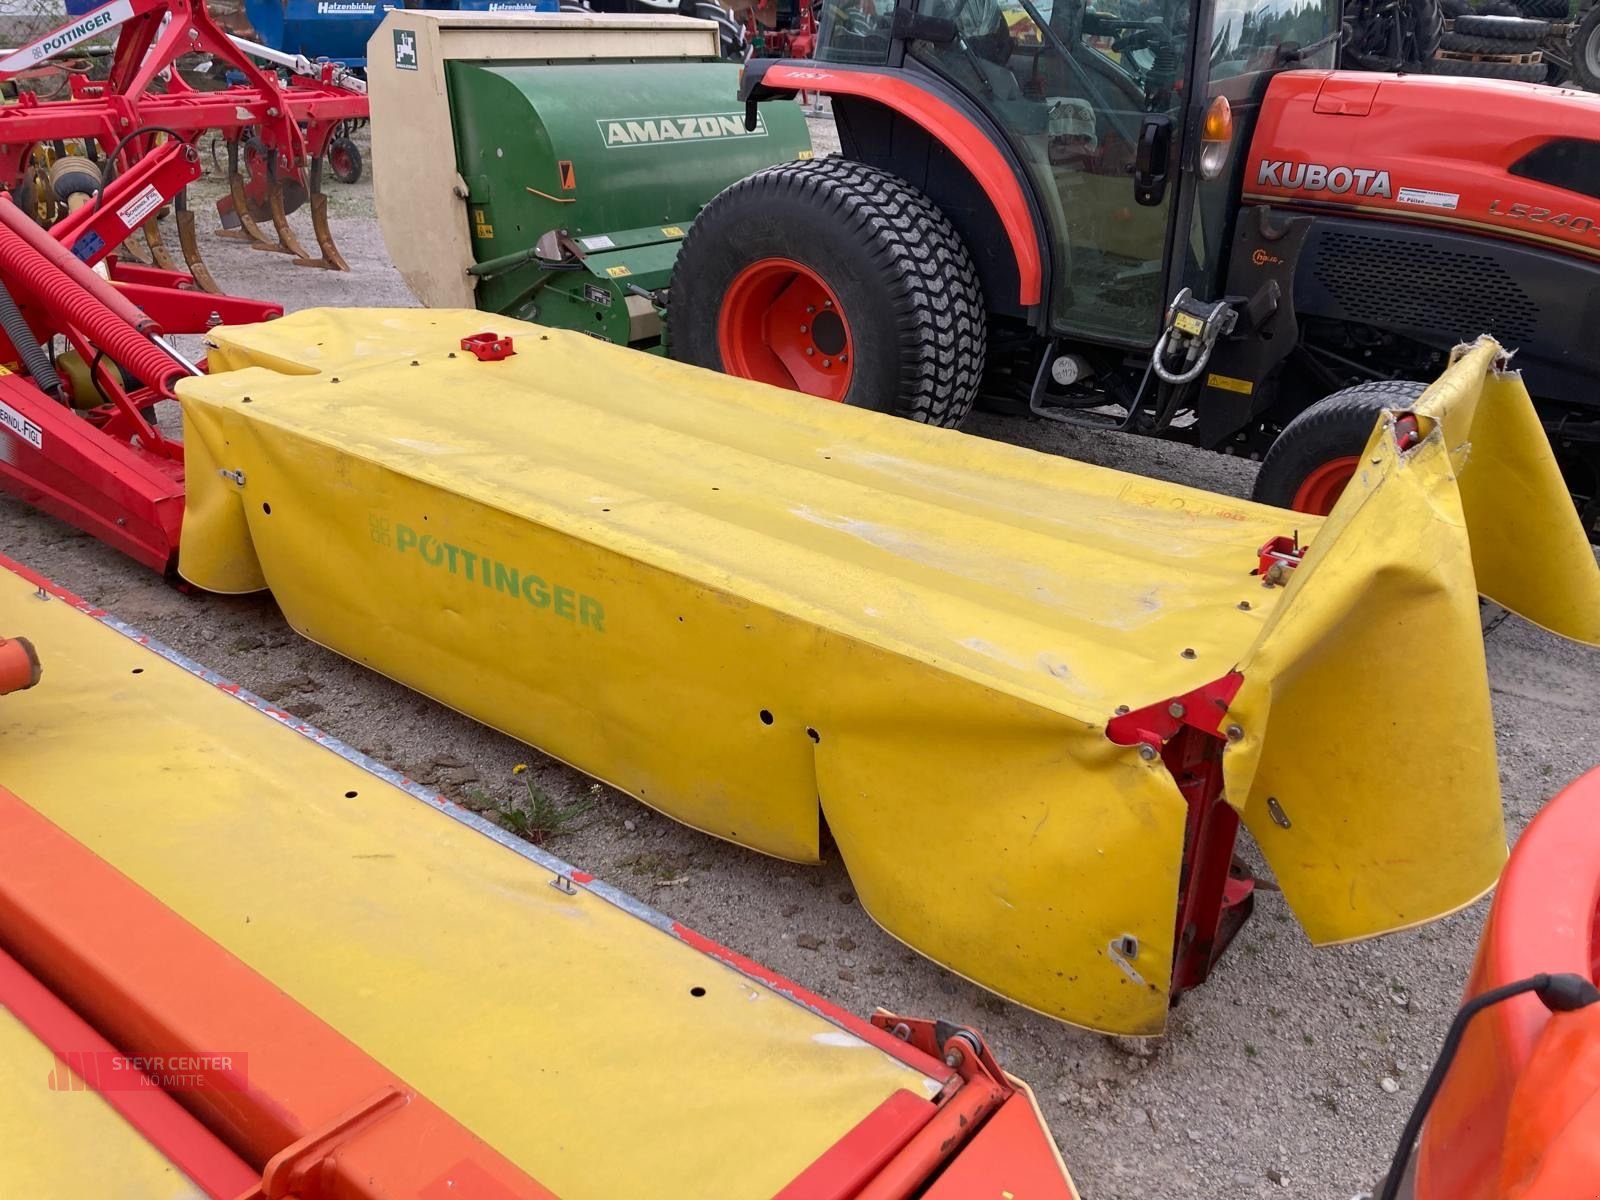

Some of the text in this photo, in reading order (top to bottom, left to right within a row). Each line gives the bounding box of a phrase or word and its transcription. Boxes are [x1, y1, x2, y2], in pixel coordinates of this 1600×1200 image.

[318, 2, 376, 14] Hatzenbichler
[488, 2, 537, 12] Hatzenbichler
[1257, 159, 1393, 199] KUBOTA
